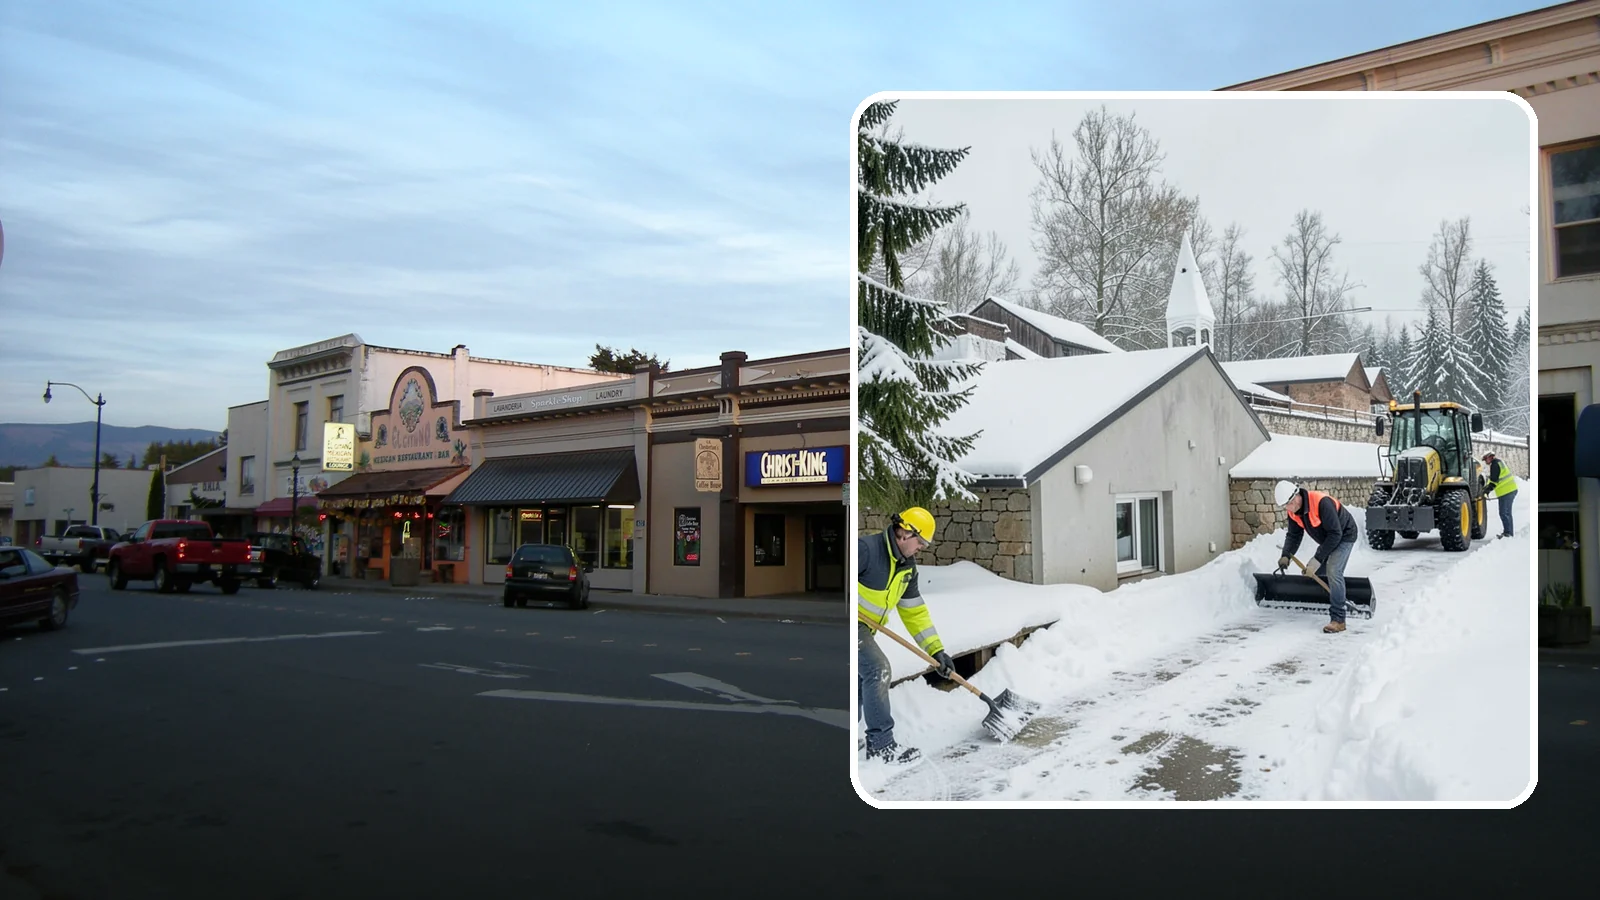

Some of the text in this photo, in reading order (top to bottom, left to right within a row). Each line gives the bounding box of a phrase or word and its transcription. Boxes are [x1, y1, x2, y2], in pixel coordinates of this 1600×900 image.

[493, 389, 624, 412] LAVANDERIA Sparkle Shop LAUNDRY
[392, 425, 402, 449] EL
[373, 455, 396, 465] MEXICAN
[397, 451, 433, 462] RESTAURANT
[437, 450, 450, 459] BAR
[799, 450, 827, 476] KING
[696, 480, 722, 489] Coffee House
